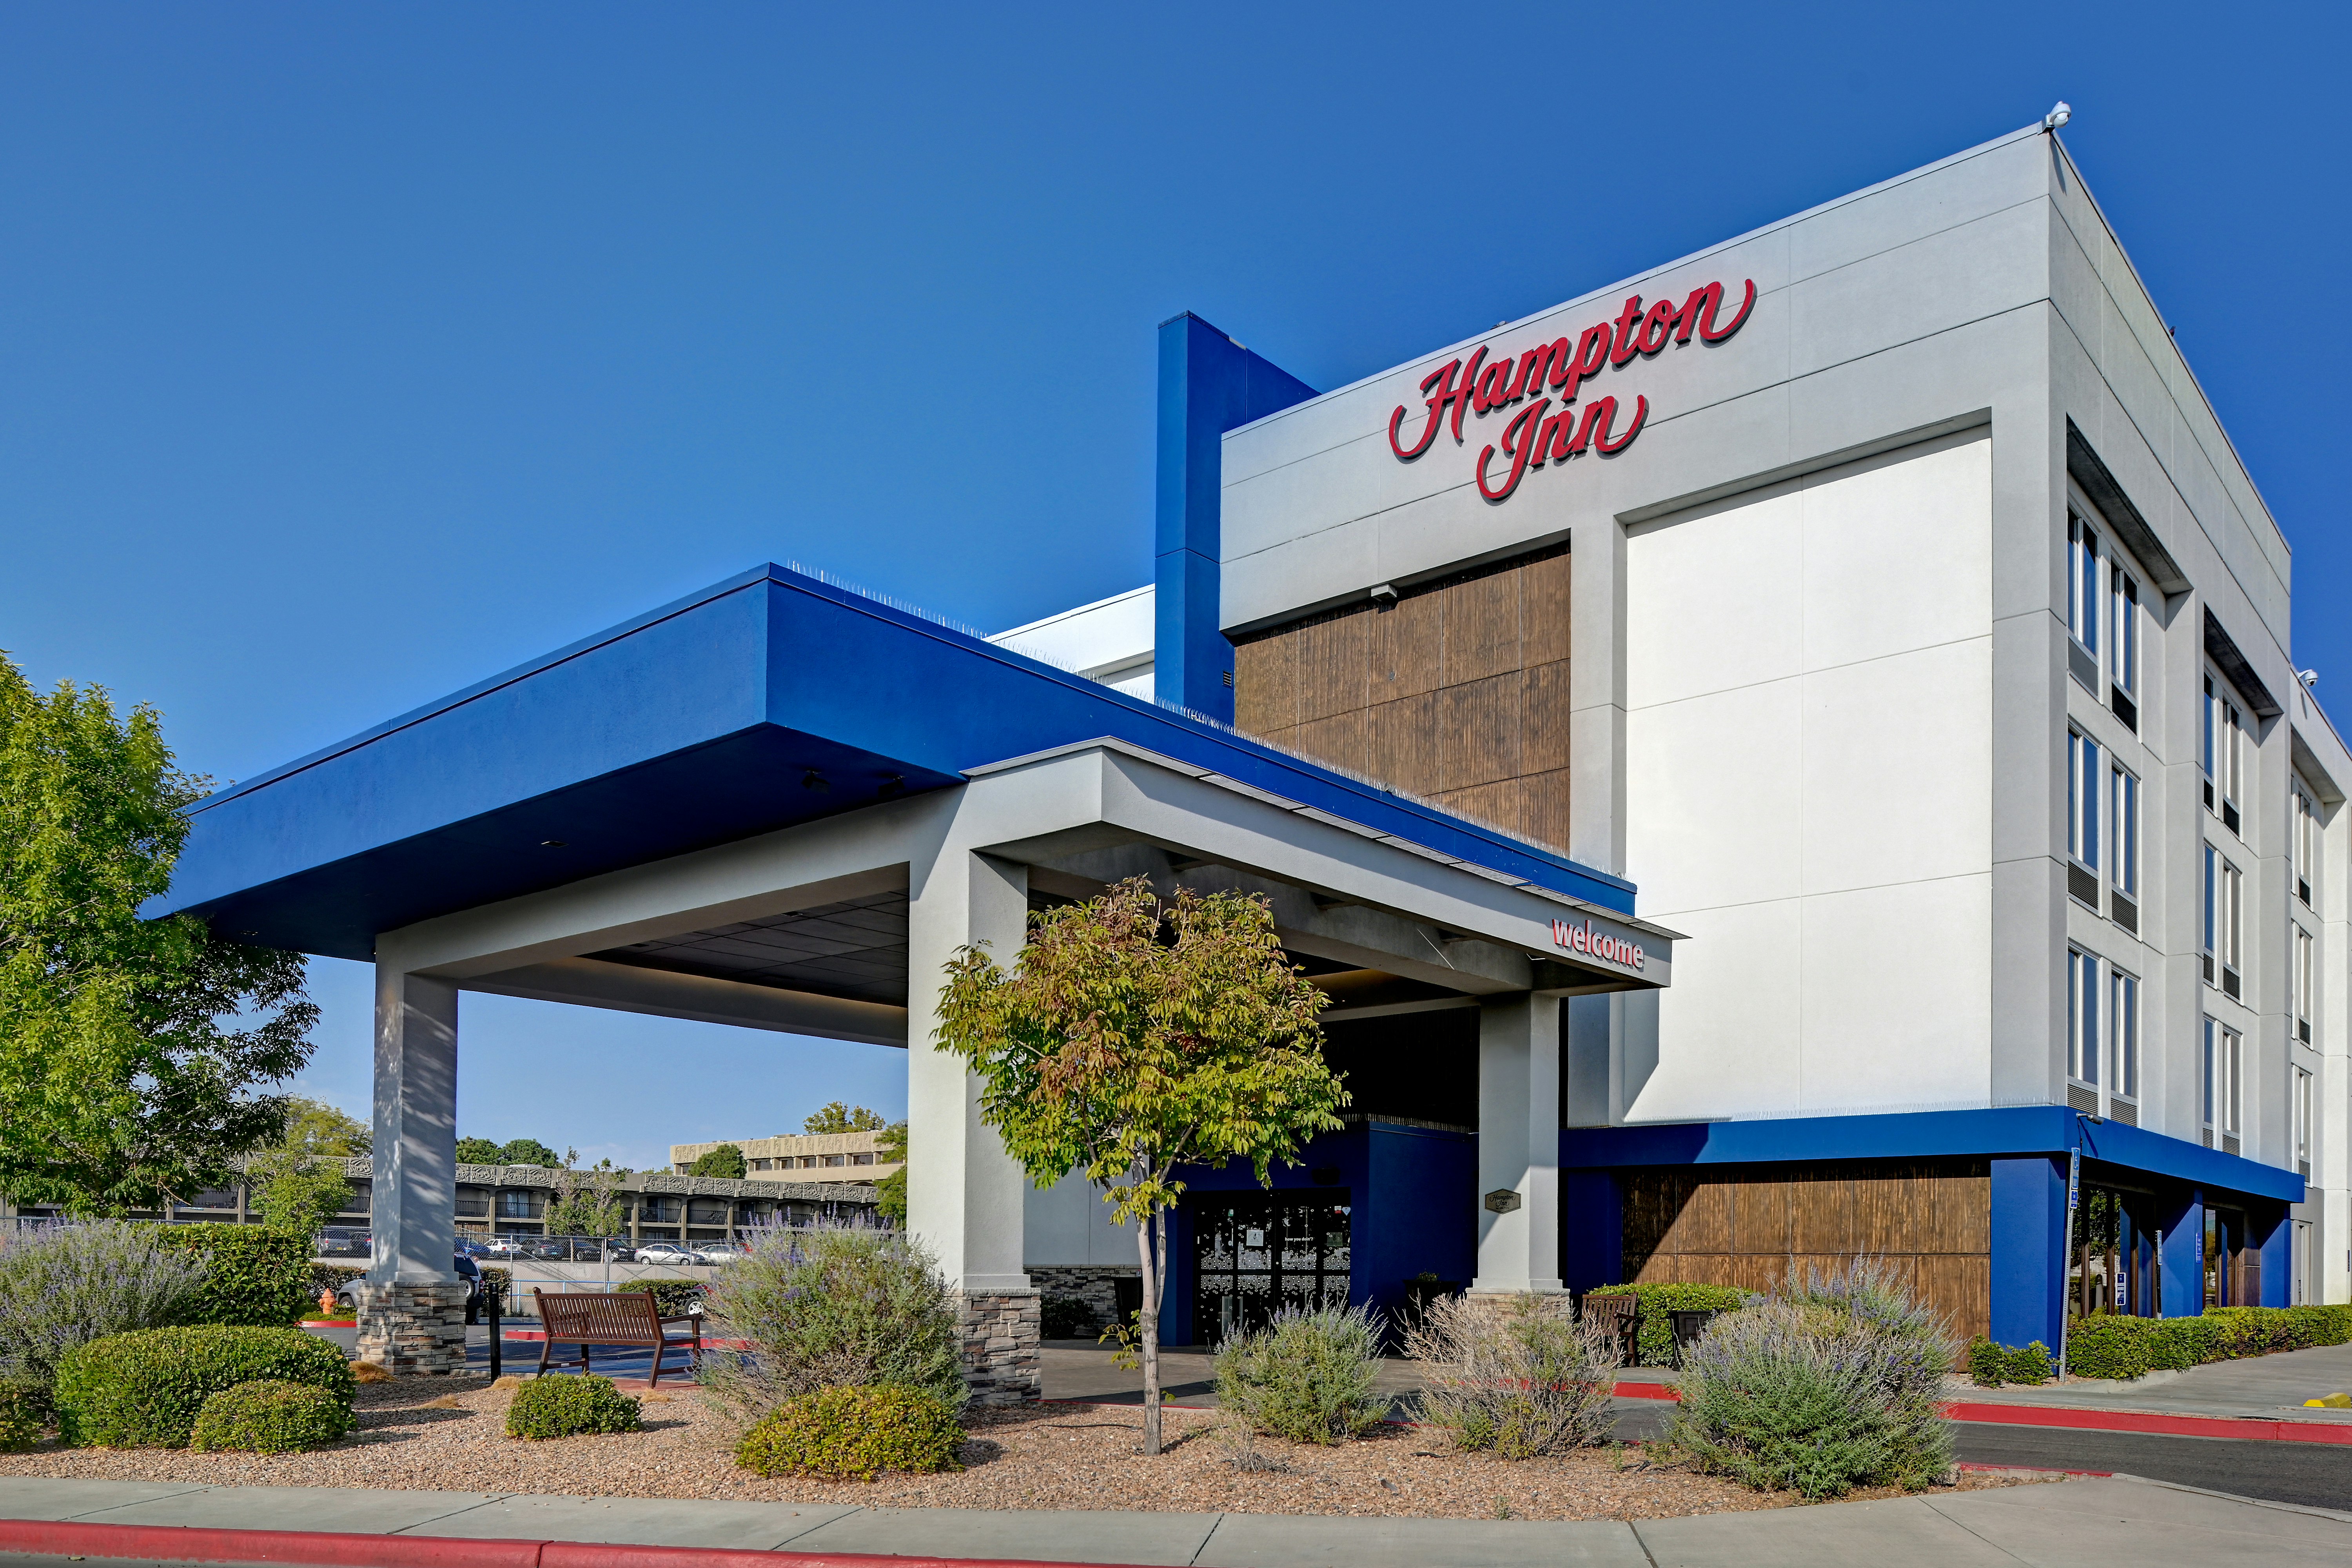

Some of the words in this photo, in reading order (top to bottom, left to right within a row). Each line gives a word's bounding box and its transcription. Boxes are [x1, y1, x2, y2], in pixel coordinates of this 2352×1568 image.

[1389, 279, 1757, 458] Hampton
[1476, 394, 1648, 501] Inn
[1552, 919, 1644, 968] welcome
